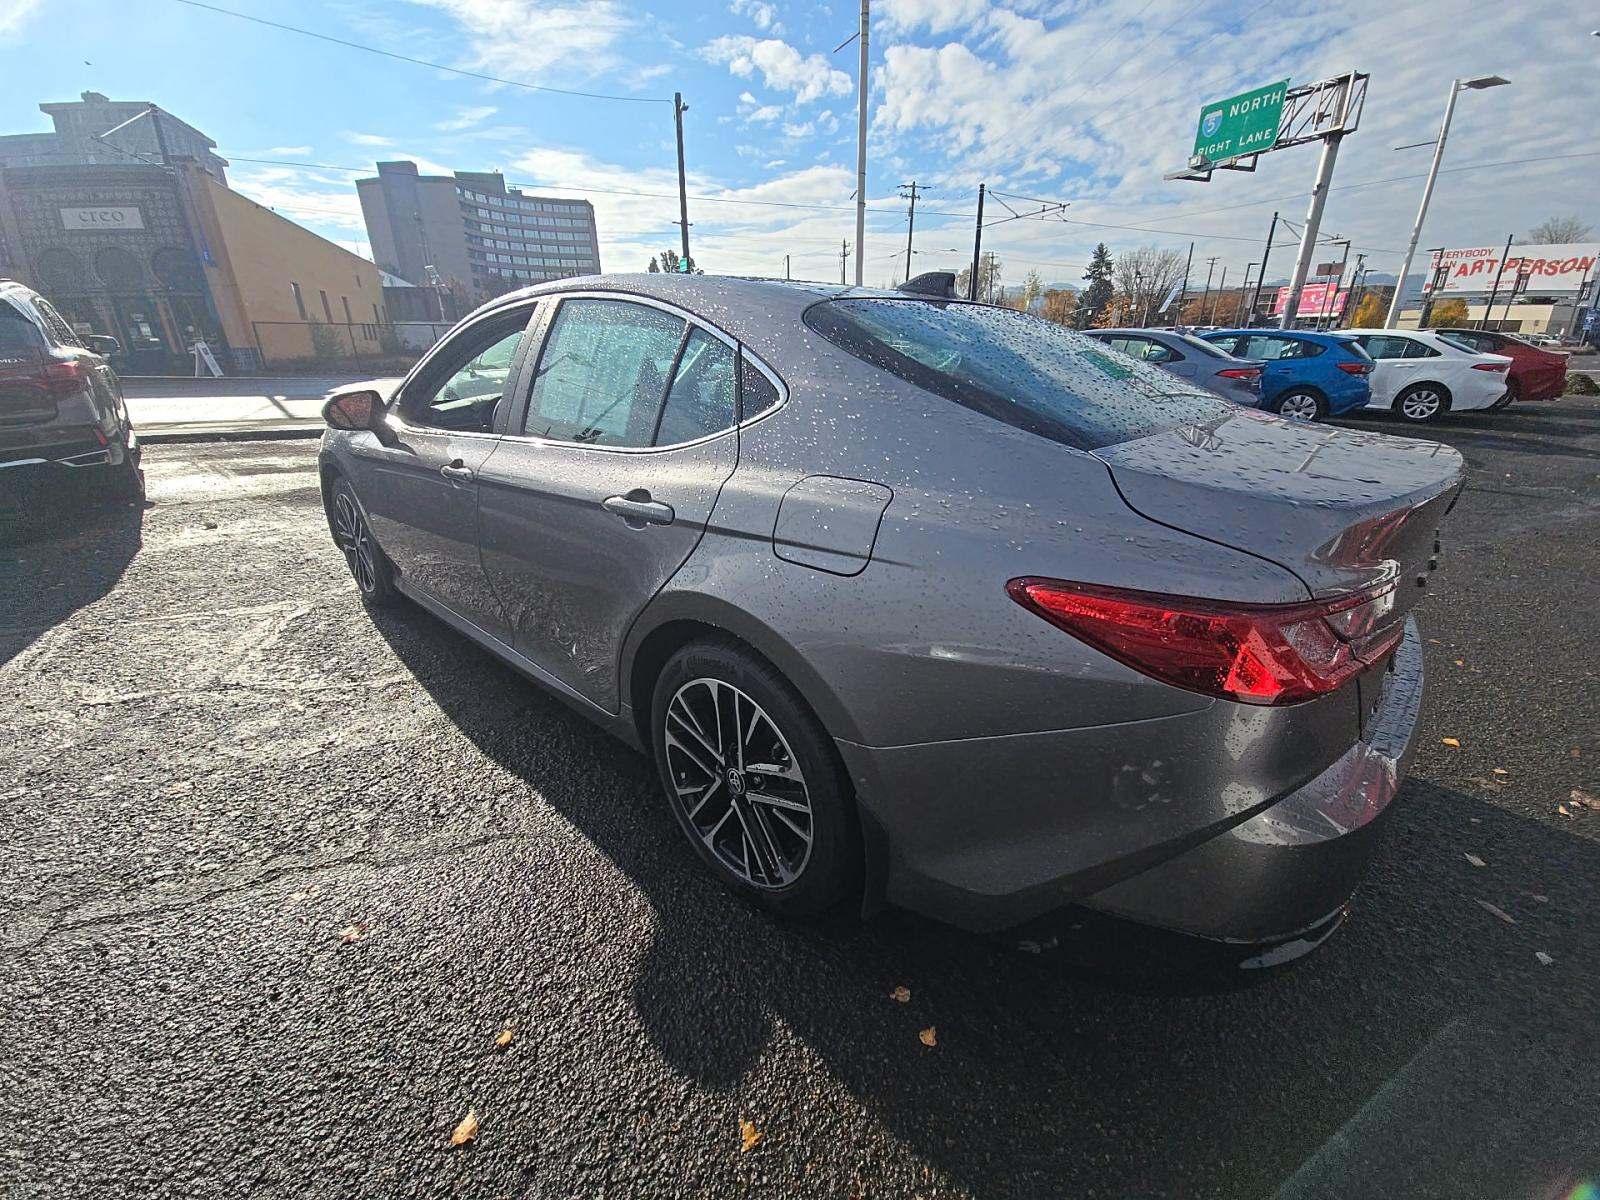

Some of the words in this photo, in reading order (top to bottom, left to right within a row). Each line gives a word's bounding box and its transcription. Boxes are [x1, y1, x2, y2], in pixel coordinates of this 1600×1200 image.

[1229, 91, 1282, 118] NORTH
[1207, 118, 1216, 133] 5
[1197, 140, 1232, 156] RIGHT
[1238, 128, 1273, 146] LANE
[1433, 248, 1495, 260] EVERYBODY
[1454, 258, 1499, 278] ART
[1502, 256, 1596, 276] PERSON
